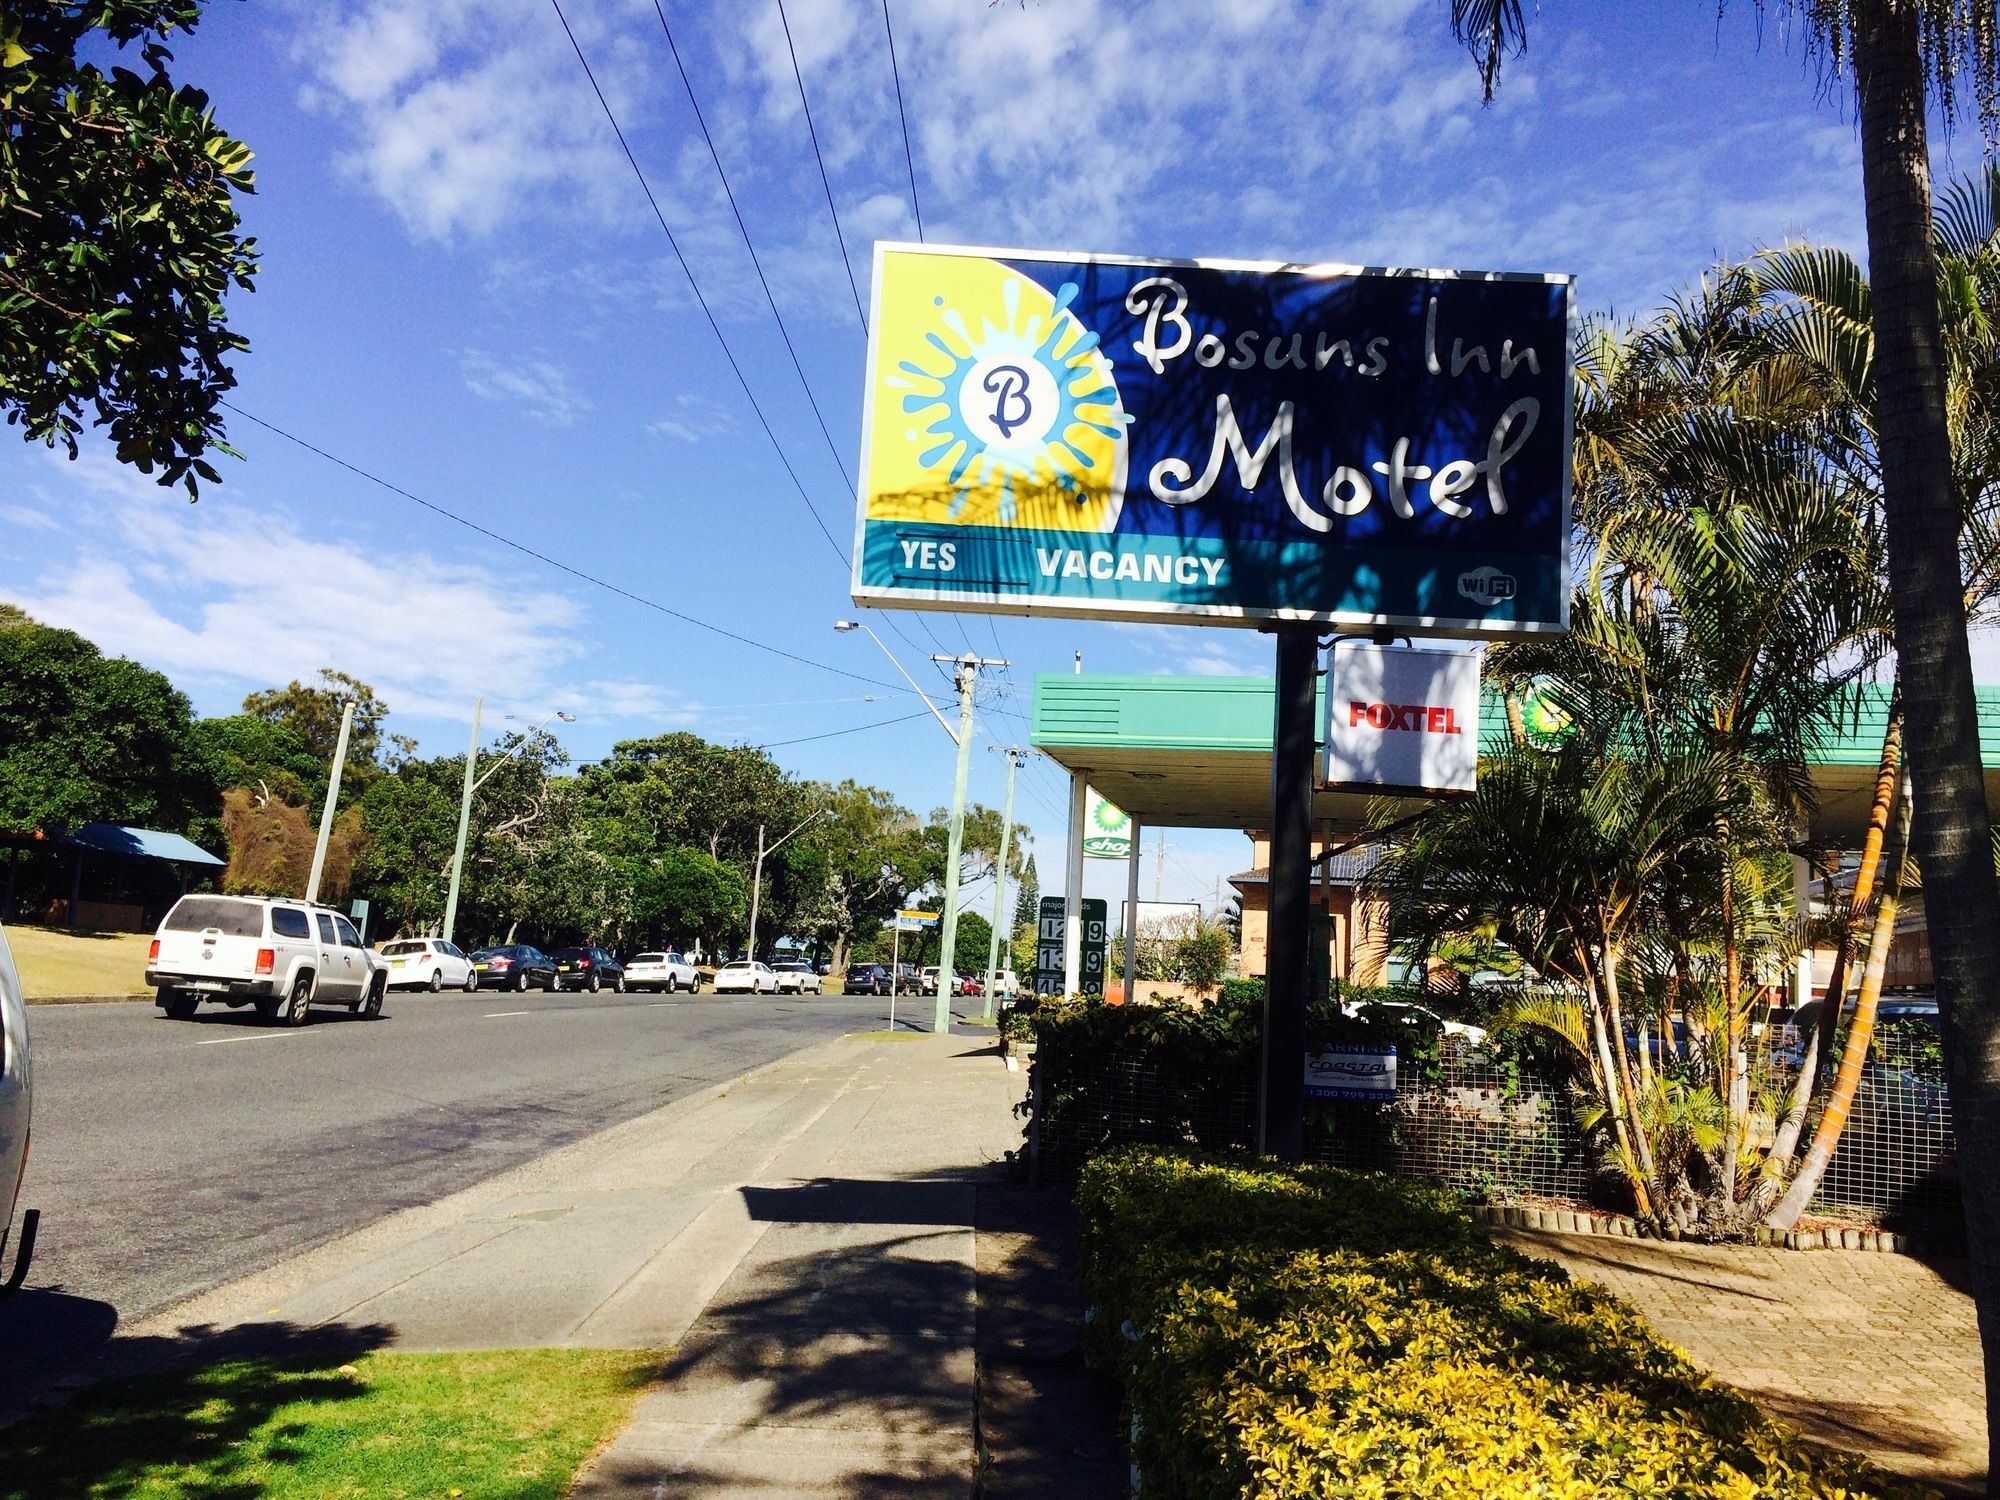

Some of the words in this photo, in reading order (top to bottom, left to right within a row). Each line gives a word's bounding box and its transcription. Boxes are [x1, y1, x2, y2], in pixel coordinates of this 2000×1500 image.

[1125, 277, 1388, 375] Bosuns
[1424, 296, 1542, 377] Inn
[982, 365, 1033, 439] B
[1148, 394, 1541, 532] Motel
[900, 540, 957, 571] YES
[1036, 547, 1226, 586] VACANCY
[1349, 701, 1461, 735] FOXTEL
[1308, 1060, 1388, 1072] COASTAL
